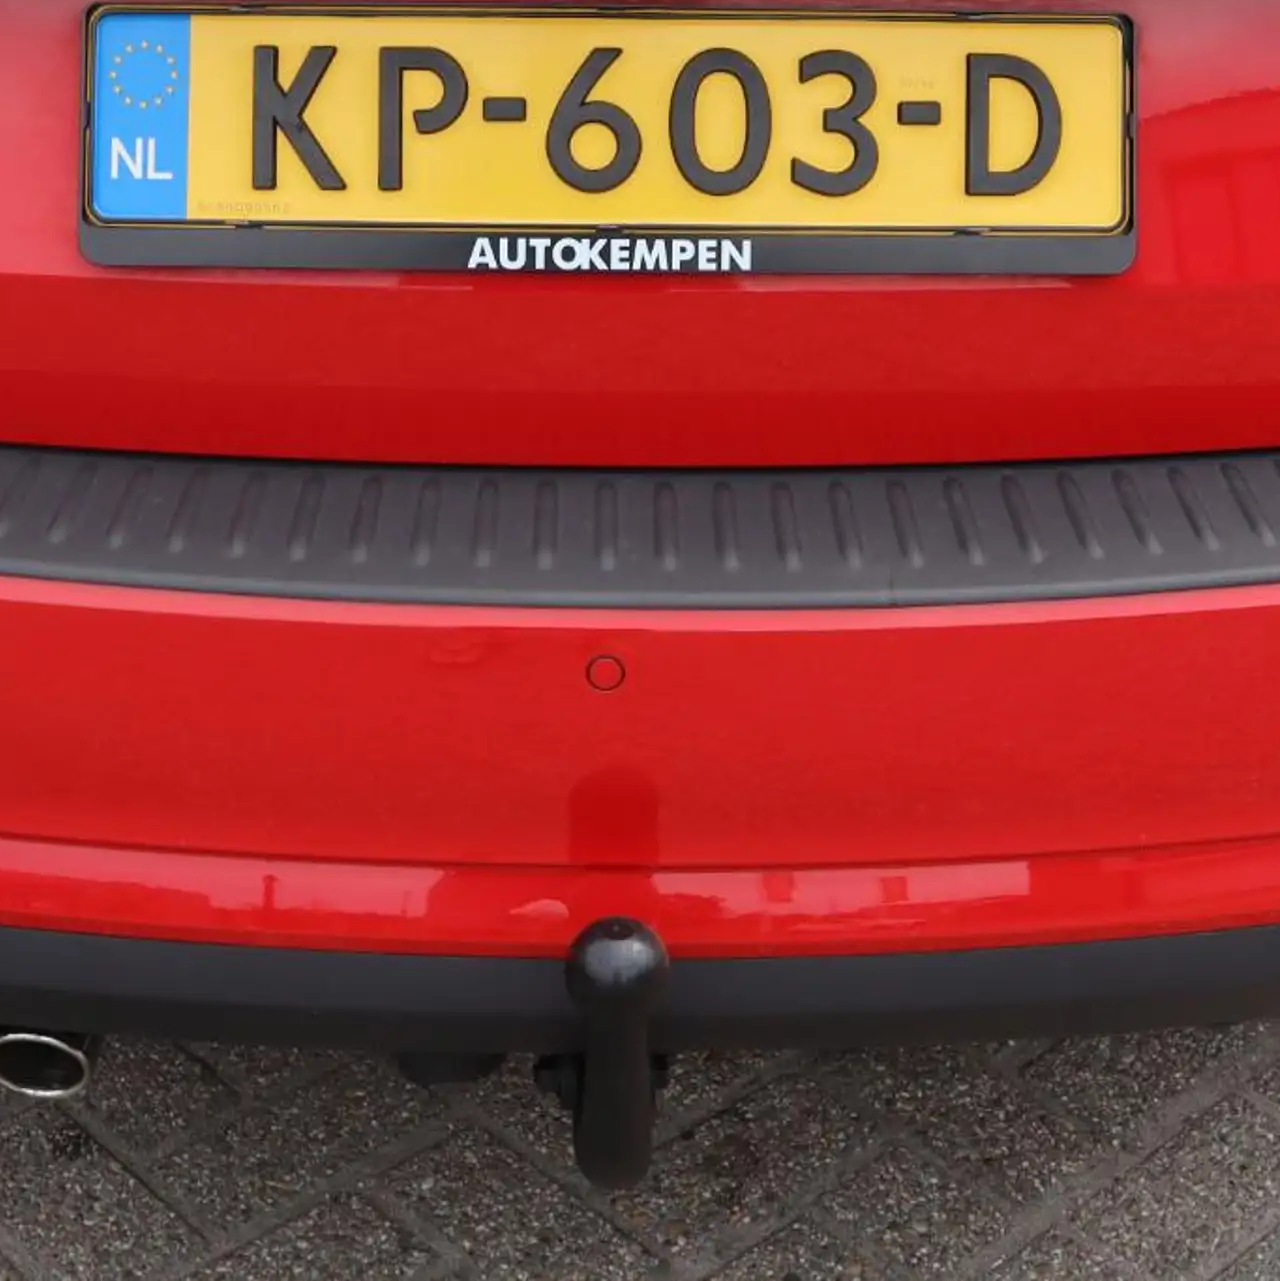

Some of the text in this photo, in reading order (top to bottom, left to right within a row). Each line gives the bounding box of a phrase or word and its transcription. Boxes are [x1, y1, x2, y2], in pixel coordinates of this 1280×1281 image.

[250, 44, 1064, 198] KP-603-D
[110, 137, 173, 181] NL
[467, 236, 753, 272] AUTOKEMPEN
